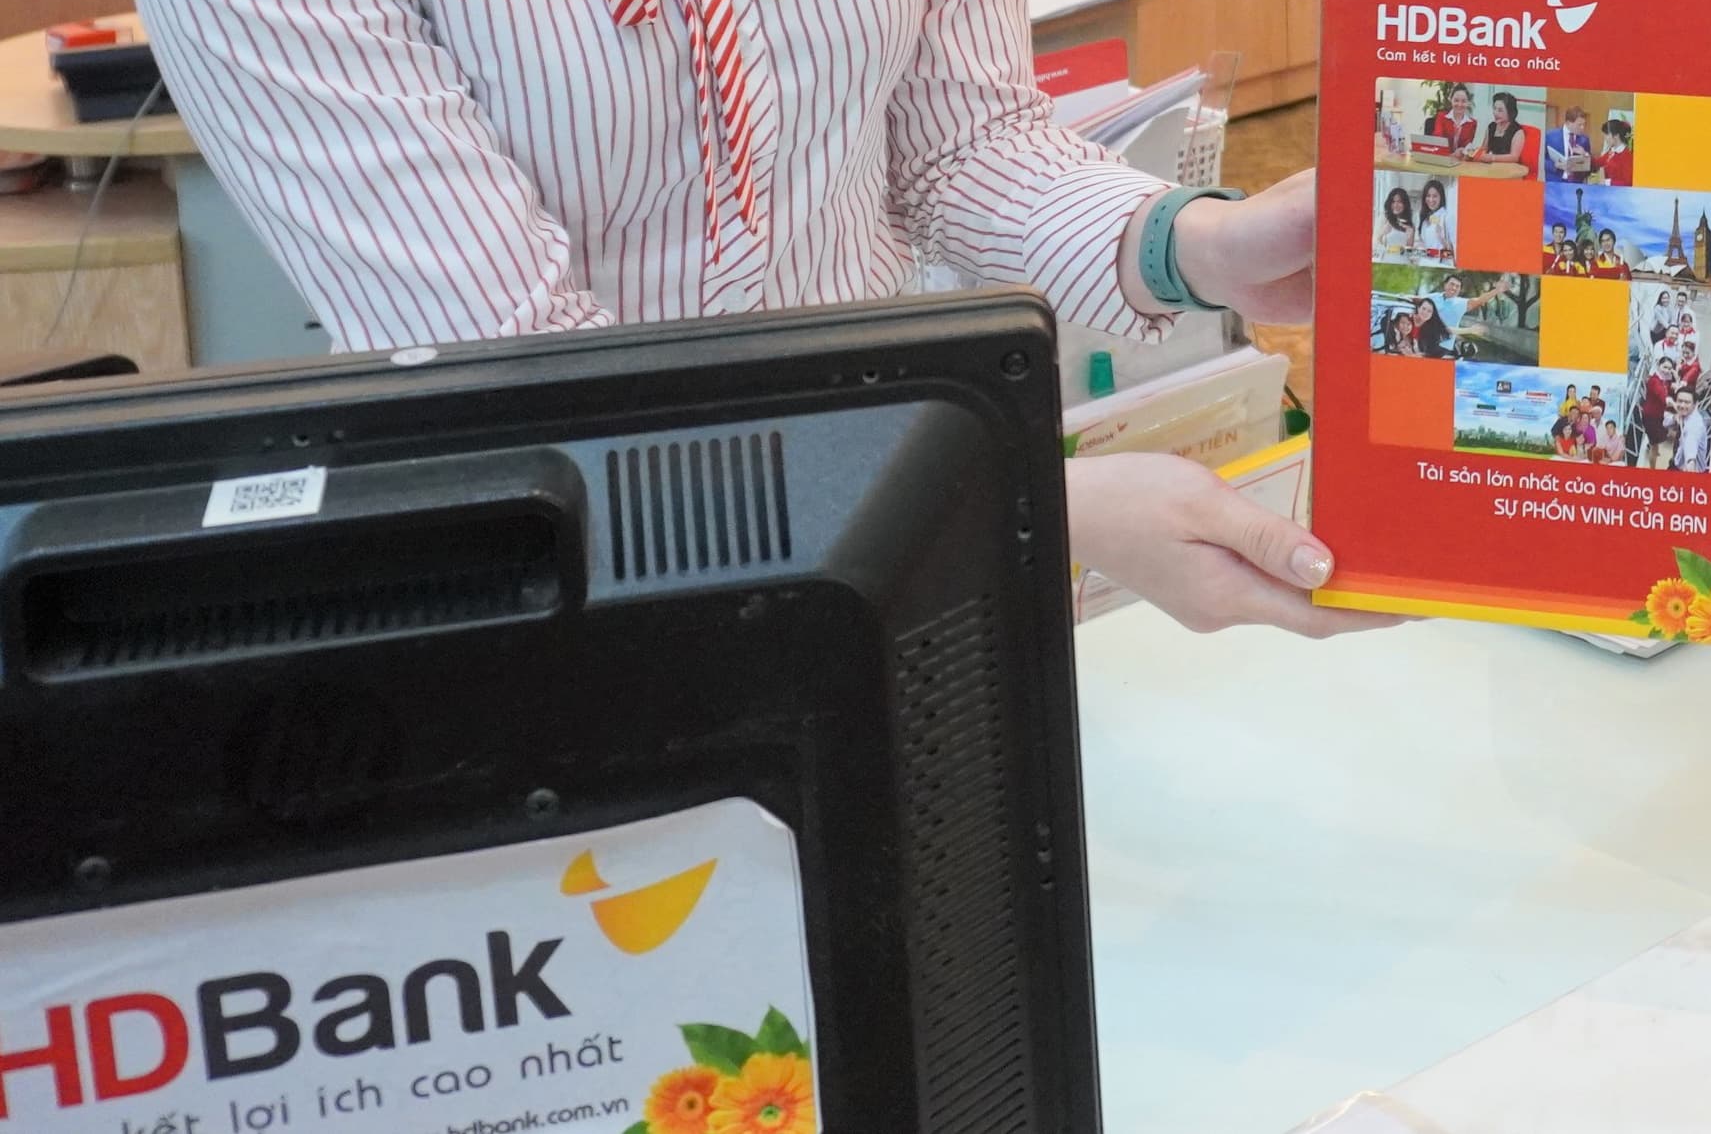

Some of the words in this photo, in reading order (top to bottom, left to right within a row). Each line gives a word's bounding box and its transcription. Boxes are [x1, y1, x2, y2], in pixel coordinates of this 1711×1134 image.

[1376, 3, 1548, 51] HDBank
[1376, 47, 1407, 62] Cam
[1412, 49, 1437, 64] kết
[1442, 51, 1462, 67] lợi
[1494, 57, 1521, 69] cao
[1527, 56, 1561, 71] nhất
[1416, 461, 1444, 481] Tài
[1449, 466, 1481, 485] sản
[1486, 468, 1514, 488] lớn
[1519, 472, 1560, 492] nhất
[1564, 476, 1596, 496] của
[1601, 479, 1654, 505] chúng
[1659, 485, 1684, 504] tôi
[1690, 486, 1708, 505] là
[1493, 498, 1519, 519] SỰ
[1580, 505, 1624, 528] VINH
[1629, 506, 1665, 531] CỦA
[1669, 514, 1708, 536] BẠN
[0, 929, 572, 1119] HDBank
[229, 1095, 289, 1134] lợi
[317, 1081, 383, 1118] ích
[410, 1065, 492, 1099] cao
[519, 1032, 626, 1082] nhất
[447, 1097, 630, 1134] hdbank.com.vn
